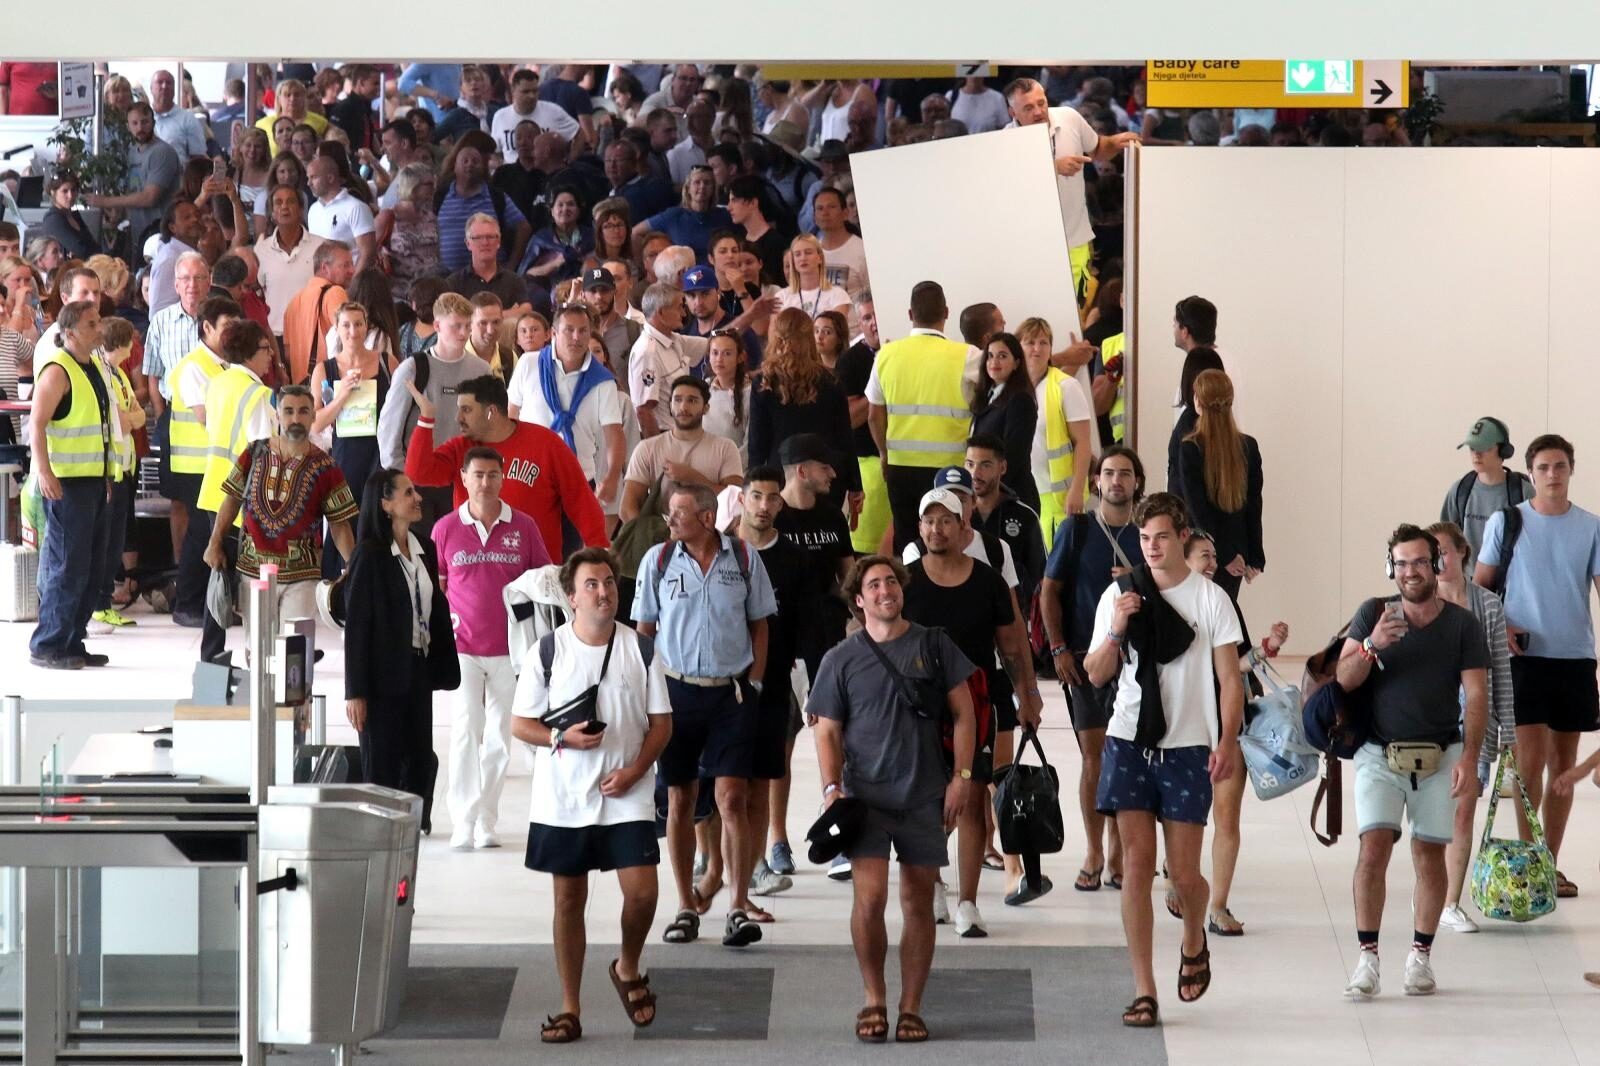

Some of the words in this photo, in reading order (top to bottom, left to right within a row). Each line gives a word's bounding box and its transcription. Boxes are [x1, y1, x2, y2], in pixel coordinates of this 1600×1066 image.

[1153, 60, 1197, 72] Baby
[1202, 60, 1240, 69] care
[1153, 72, 1177, 80] Njega
[1179, 72, 1207, 80] djeteta
[507, 457, 540, 487] AIR
[452, 550, 521, 567] Bahamas
[667, 572, 689, 601] 71
